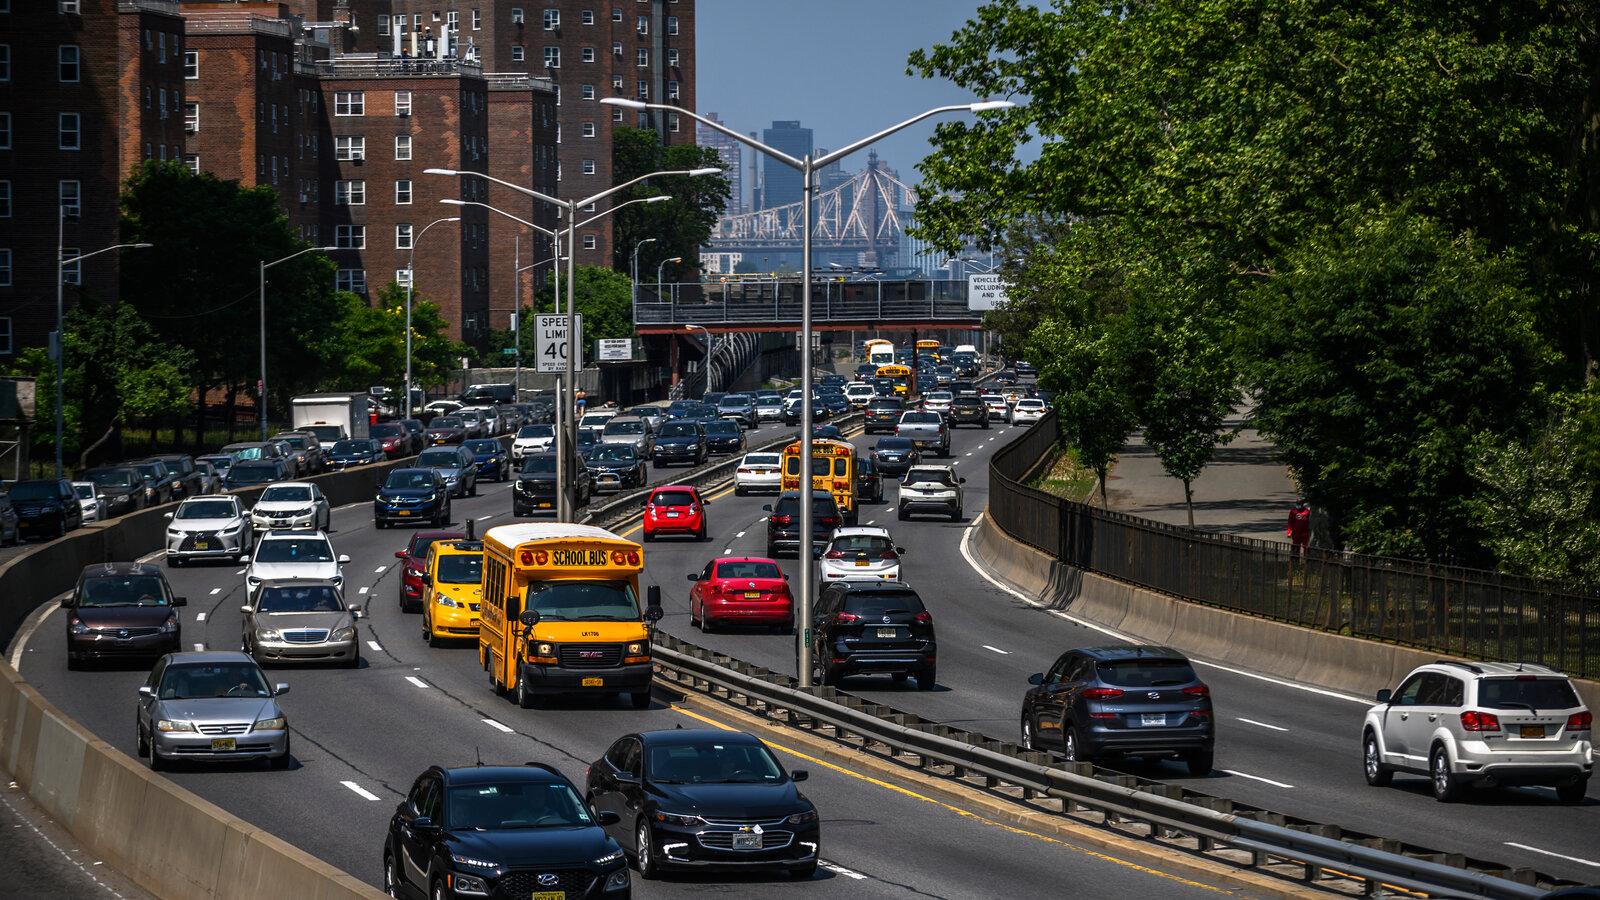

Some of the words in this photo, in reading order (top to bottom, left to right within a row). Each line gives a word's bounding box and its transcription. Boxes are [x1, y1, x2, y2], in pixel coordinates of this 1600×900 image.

[542, 317, 567, 327] SPEE
[545, 330, 567, 339] LIMI
[553, 550, 588, 565] SCHOOL
[590, 550, 607, 565] BUS
